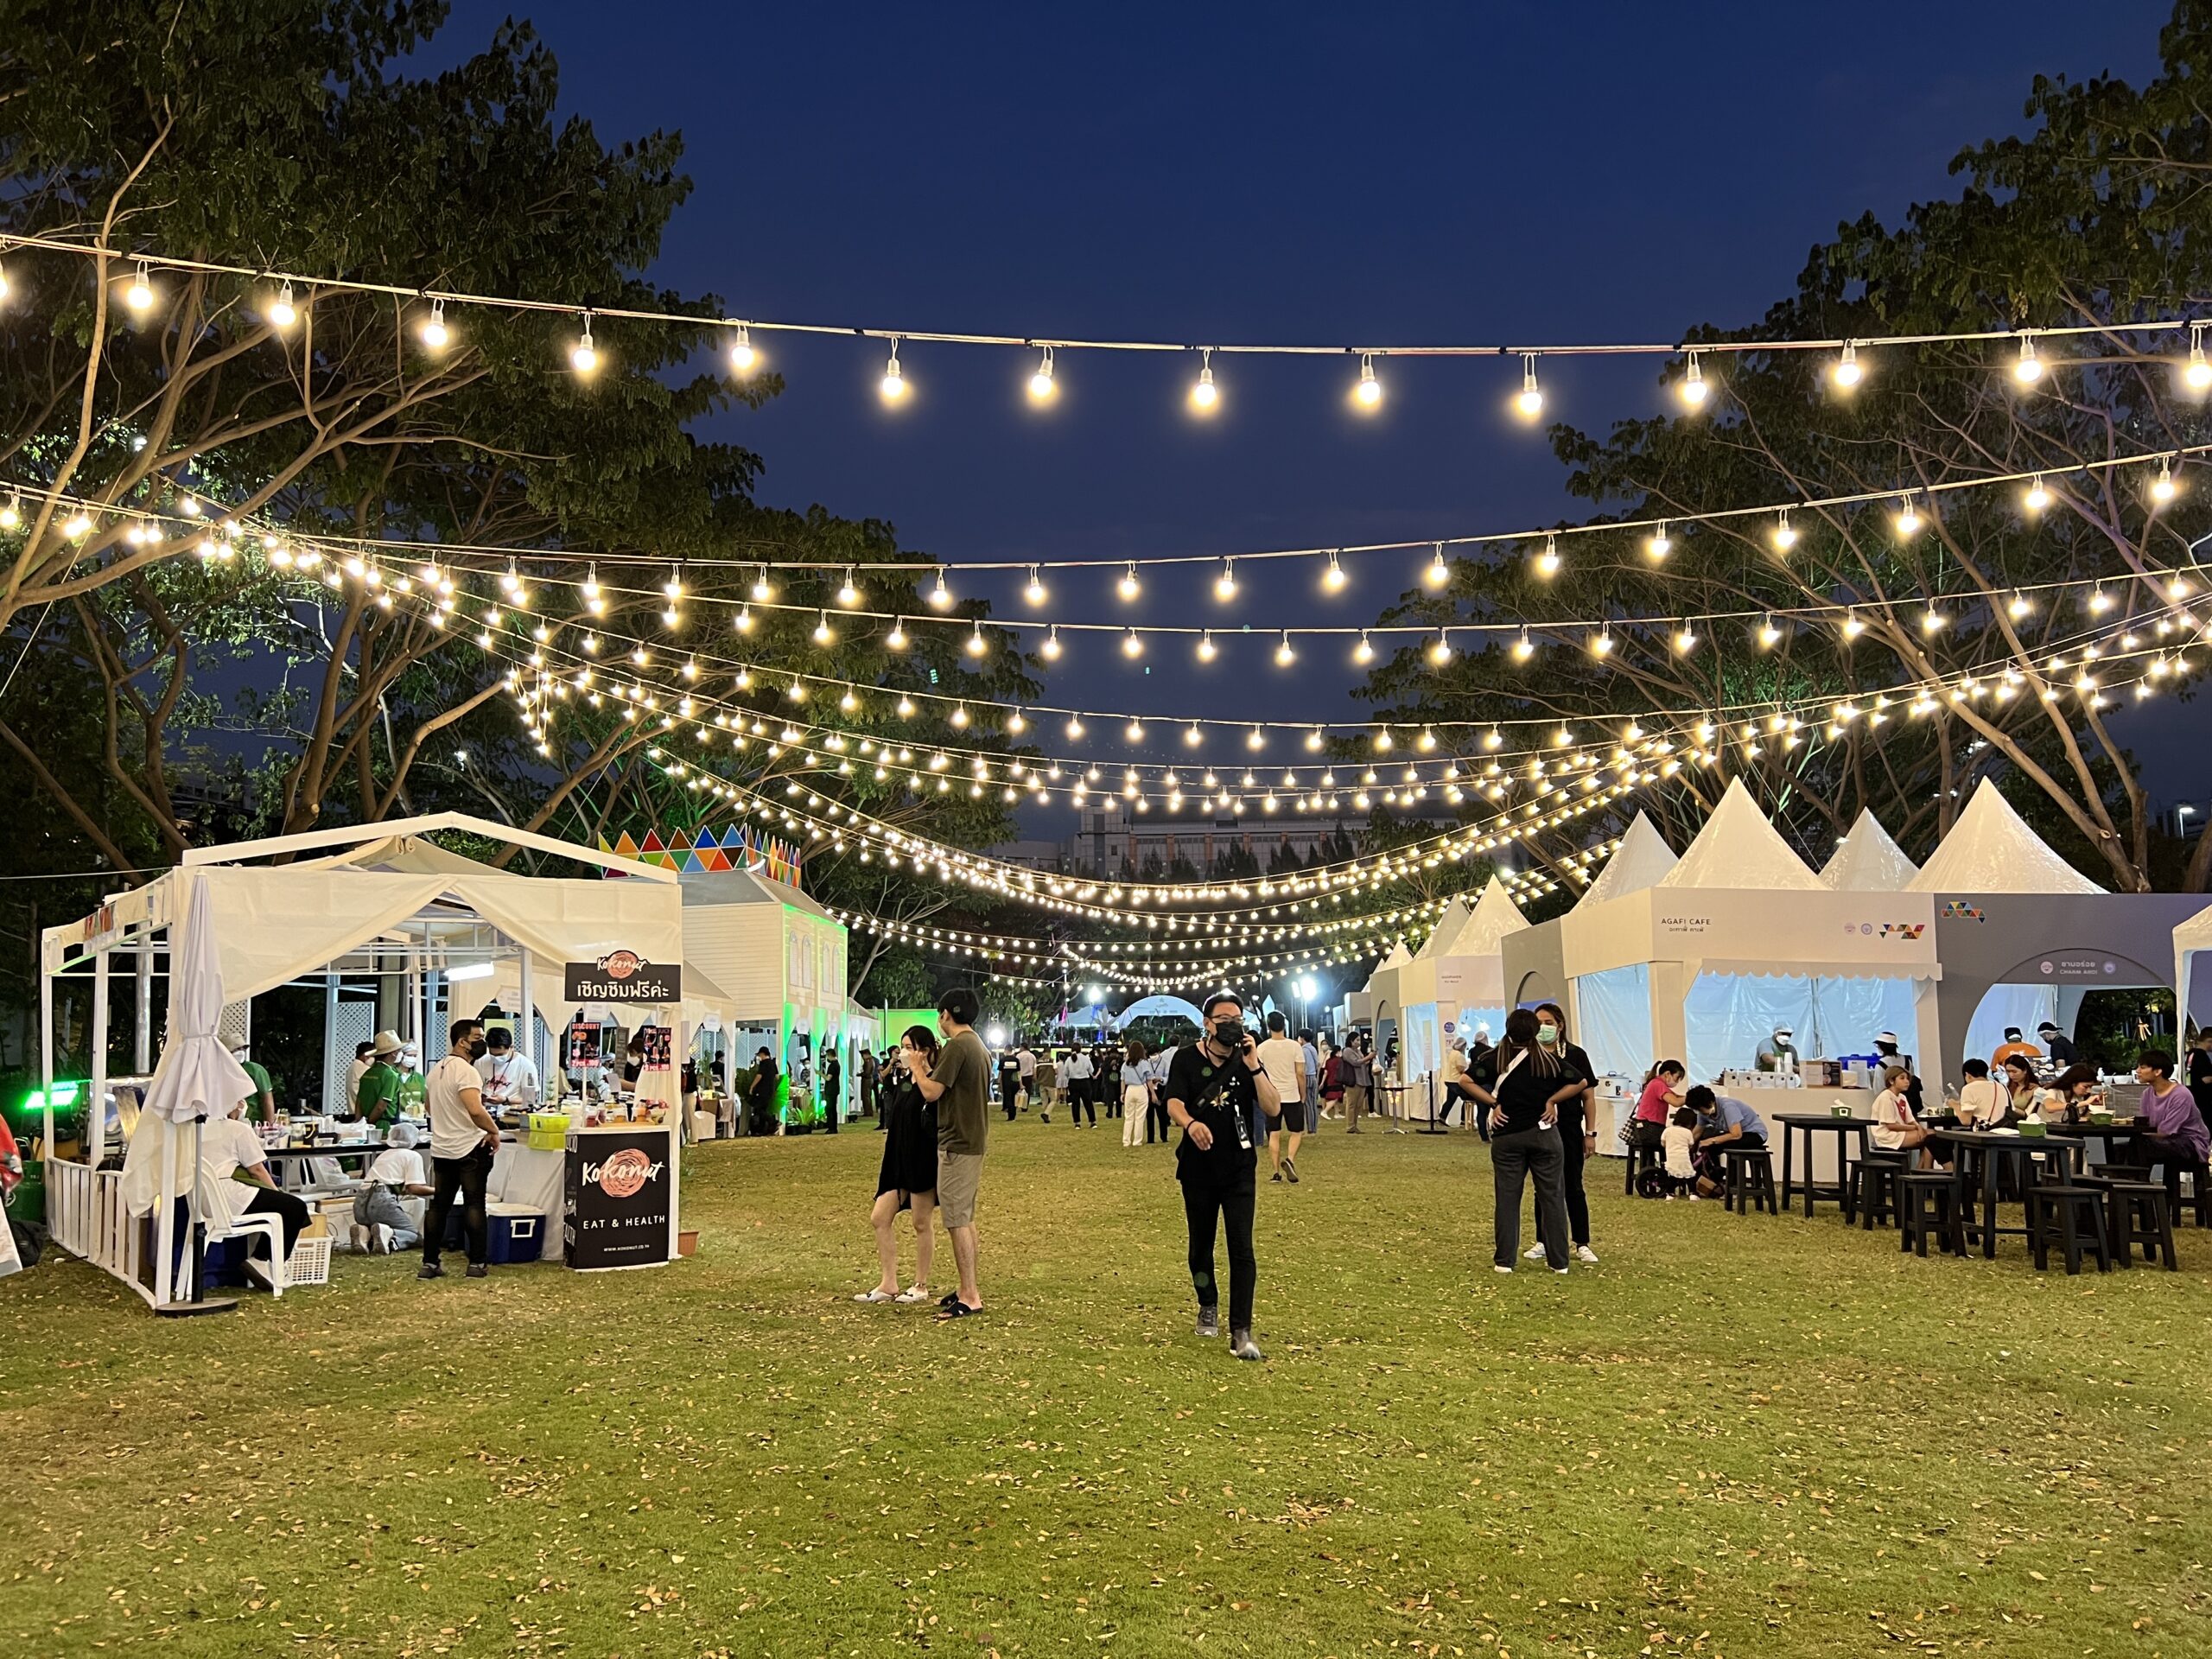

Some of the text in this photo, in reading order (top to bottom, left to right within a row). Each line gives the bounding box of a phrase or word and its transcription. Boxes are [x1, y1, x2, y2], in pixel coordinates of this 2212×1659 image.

[577, 979, 670, 999] เชิญชิมฟรีค่ะ
[571, 1022, 601, 1031] DISCOUNT
[582, 1154, 665, 1186] Kokonut
[583, 1214, 665, 1230] EAT & HEALTH
